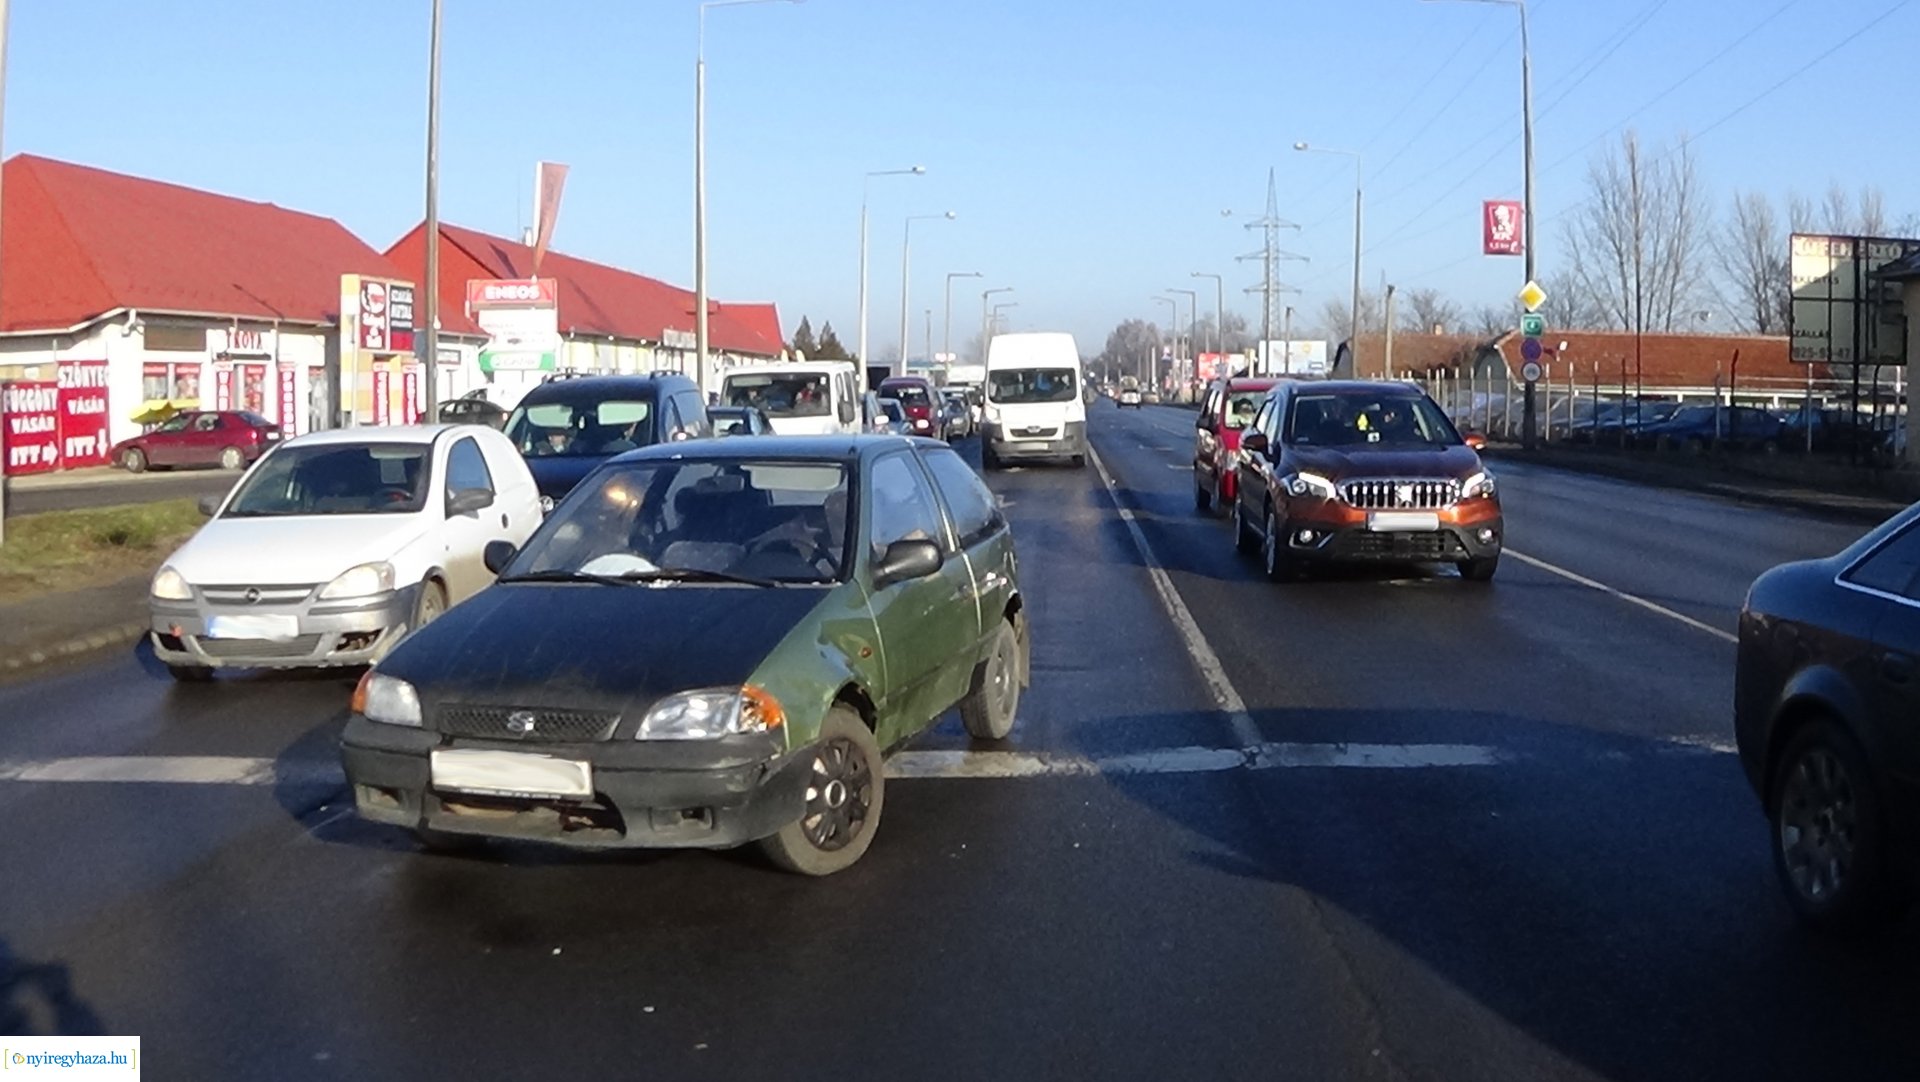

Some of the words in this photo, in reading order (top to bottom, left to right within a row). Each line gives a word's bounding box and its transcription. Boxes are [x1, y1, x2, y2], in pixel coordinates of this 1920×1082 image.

[485, 285, 540, 300] ENEOS
[67, 395, 105, 415] VÁSÁR
[11, 413, 55, 434] VÁSÁR
[10, 445, 41, 466] ITT
[65, 436, 96, 457] ITT
